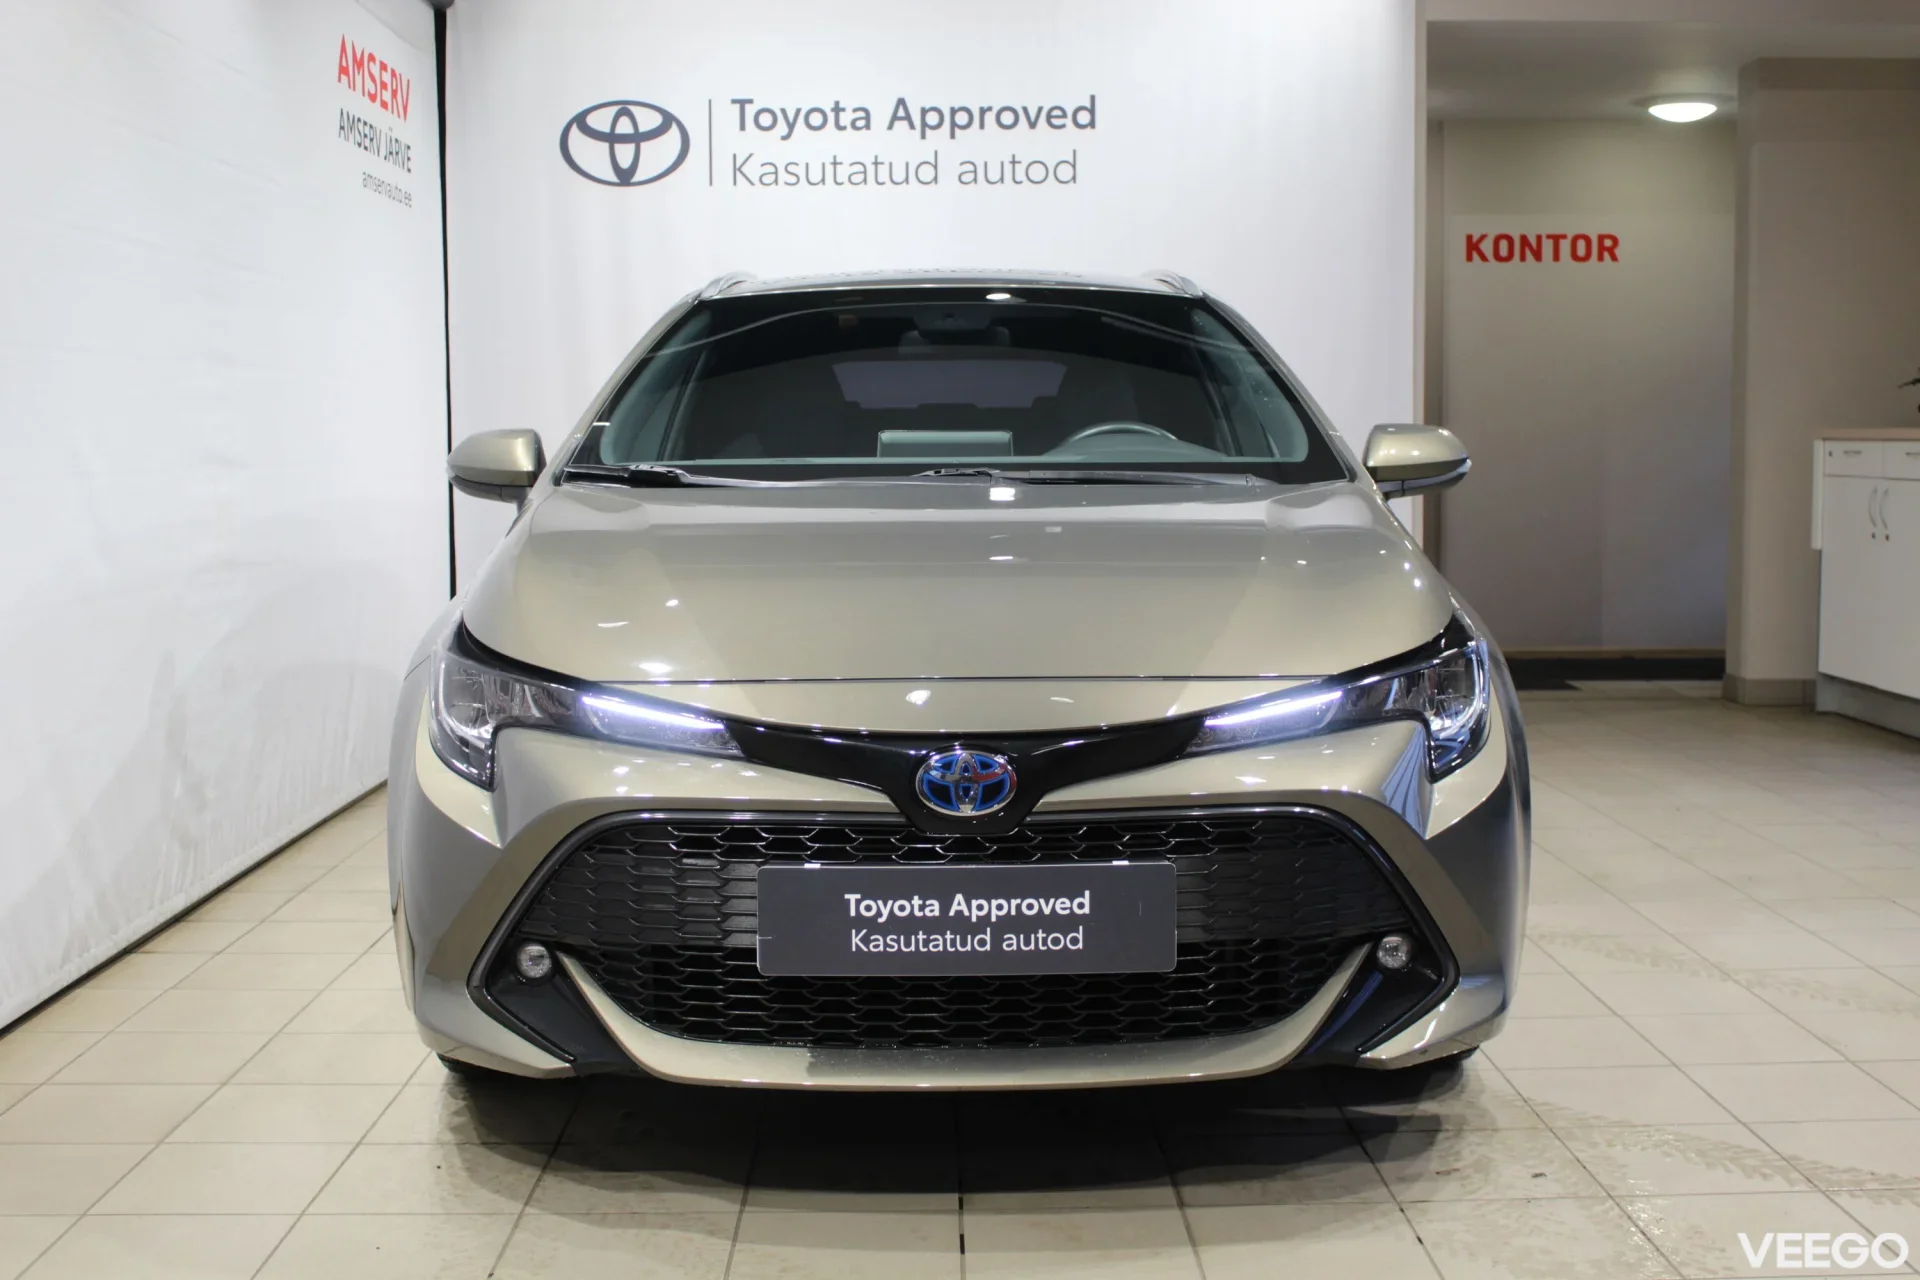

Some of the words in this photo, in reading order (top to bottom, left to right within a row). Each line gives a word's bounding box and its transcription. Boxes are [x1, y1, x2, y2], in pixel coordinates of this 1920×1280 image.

[337, 33, 410, 123] AMSERV
[731, 98, 872, 140] Toyota
[886, 95, 1097, 140] Approved
[338, 107, 382, 158] AMSERV
[384, 126, 412, 174] JÄRVE
[732, 149, 939, 186] Kasutatud
[957, 149, 1078, 185] autod
[362, 171, 412, 208] amservauto.ee
[1465, 233, 1620, 263] KONTOR
[844, 893, 940, 923] Toyota
[949, 890, 1091, 922] Approved
[851, 928, 991, 952] Kasutatud
[1002, 926, 1084, 951] autod
